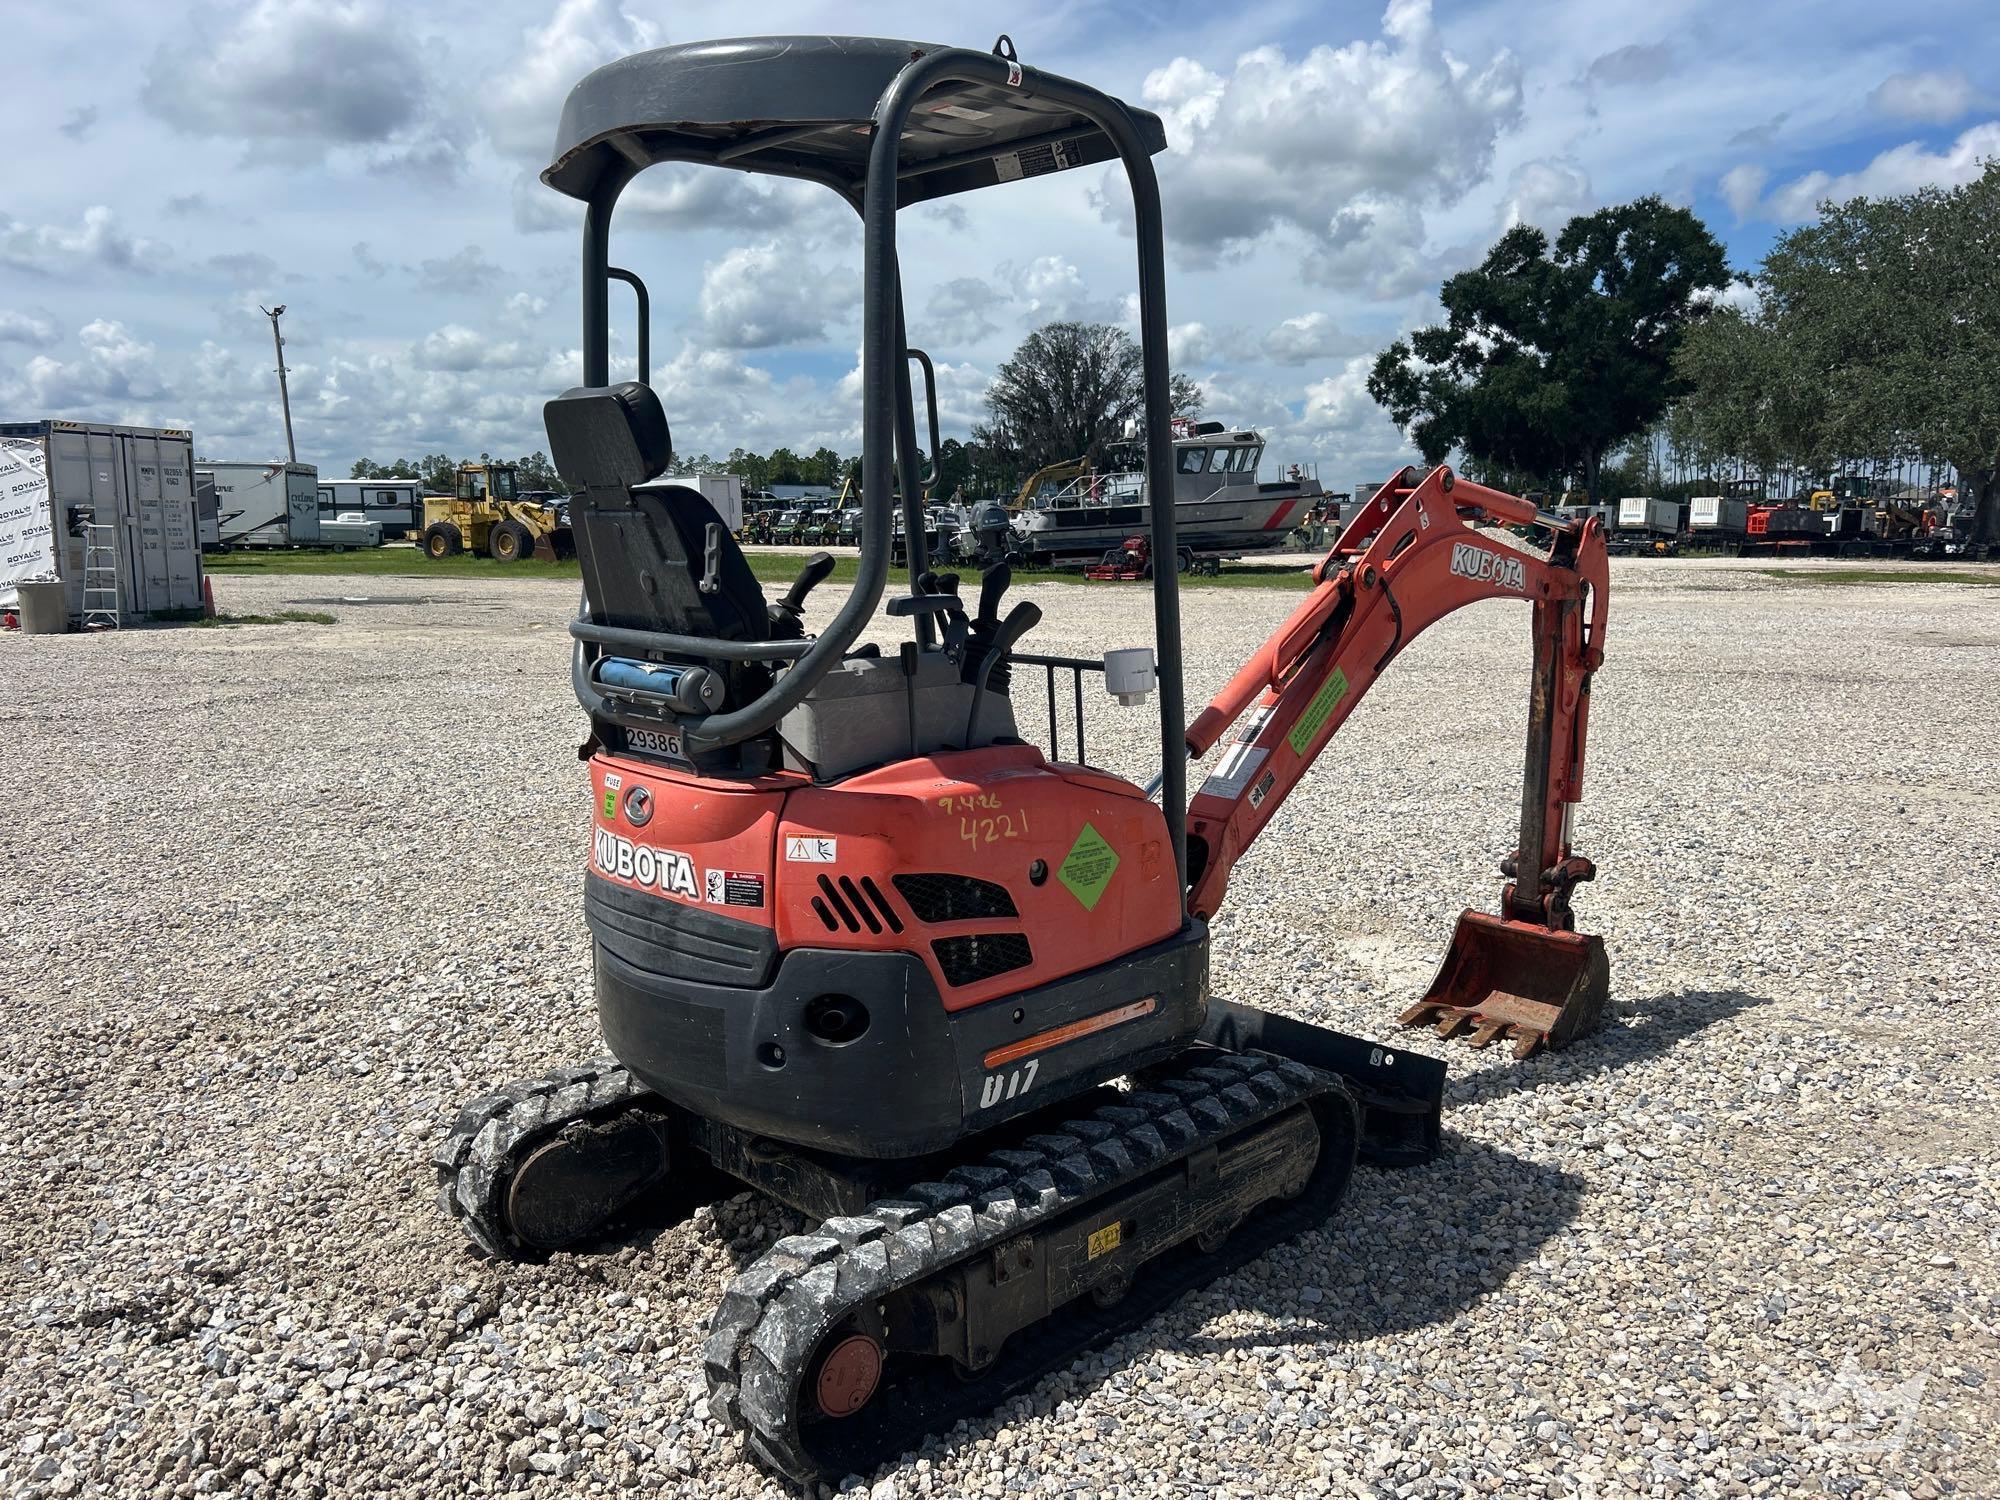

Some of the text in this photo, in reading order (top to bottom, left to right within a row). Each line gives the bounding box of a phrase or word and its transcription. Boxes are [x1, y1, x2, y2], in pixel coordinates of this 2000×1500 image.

[12, 480, 39, 492] ROYAL
[22, 525, 49, 536] ROYAL
[7, 552, 34, 563] ROYAL
[1451, 543, 1526, 590] KUBOTA
[626, 728, 681, 755] 29386
[606, 776, 620, 787] FUSE
[960, 808, 1029, 852] 4221
[595, 826, 699, 899] KUBOTA
[980, 1058, 1040, 1109] U17
